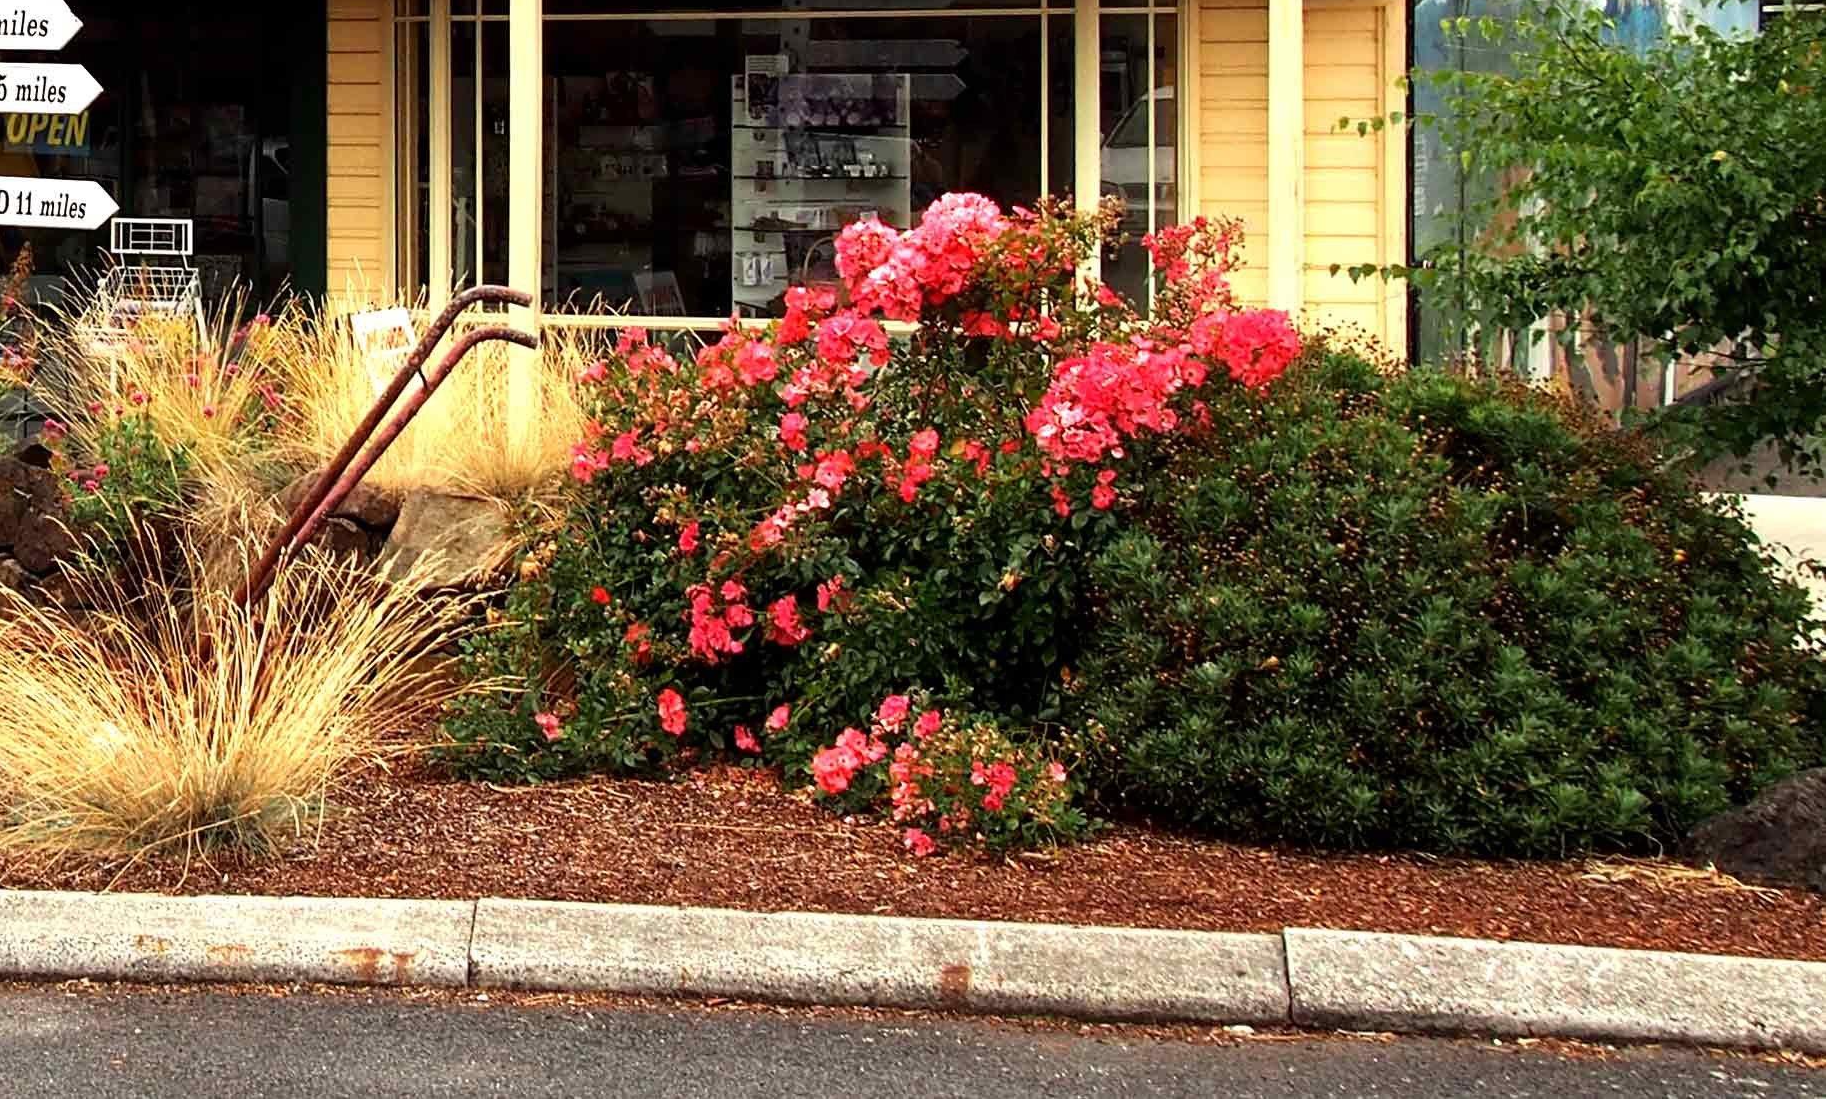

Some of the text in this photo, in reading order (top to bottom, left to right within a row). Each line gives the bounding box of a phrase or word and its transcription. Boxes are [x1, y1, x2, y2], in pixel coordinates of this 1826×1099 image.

[15, 77, 68, 104] miles
[6, 110, 88, 146] OPEN
[15, 190, 33, 216] 11
[39, 193, 88, 220] miles
